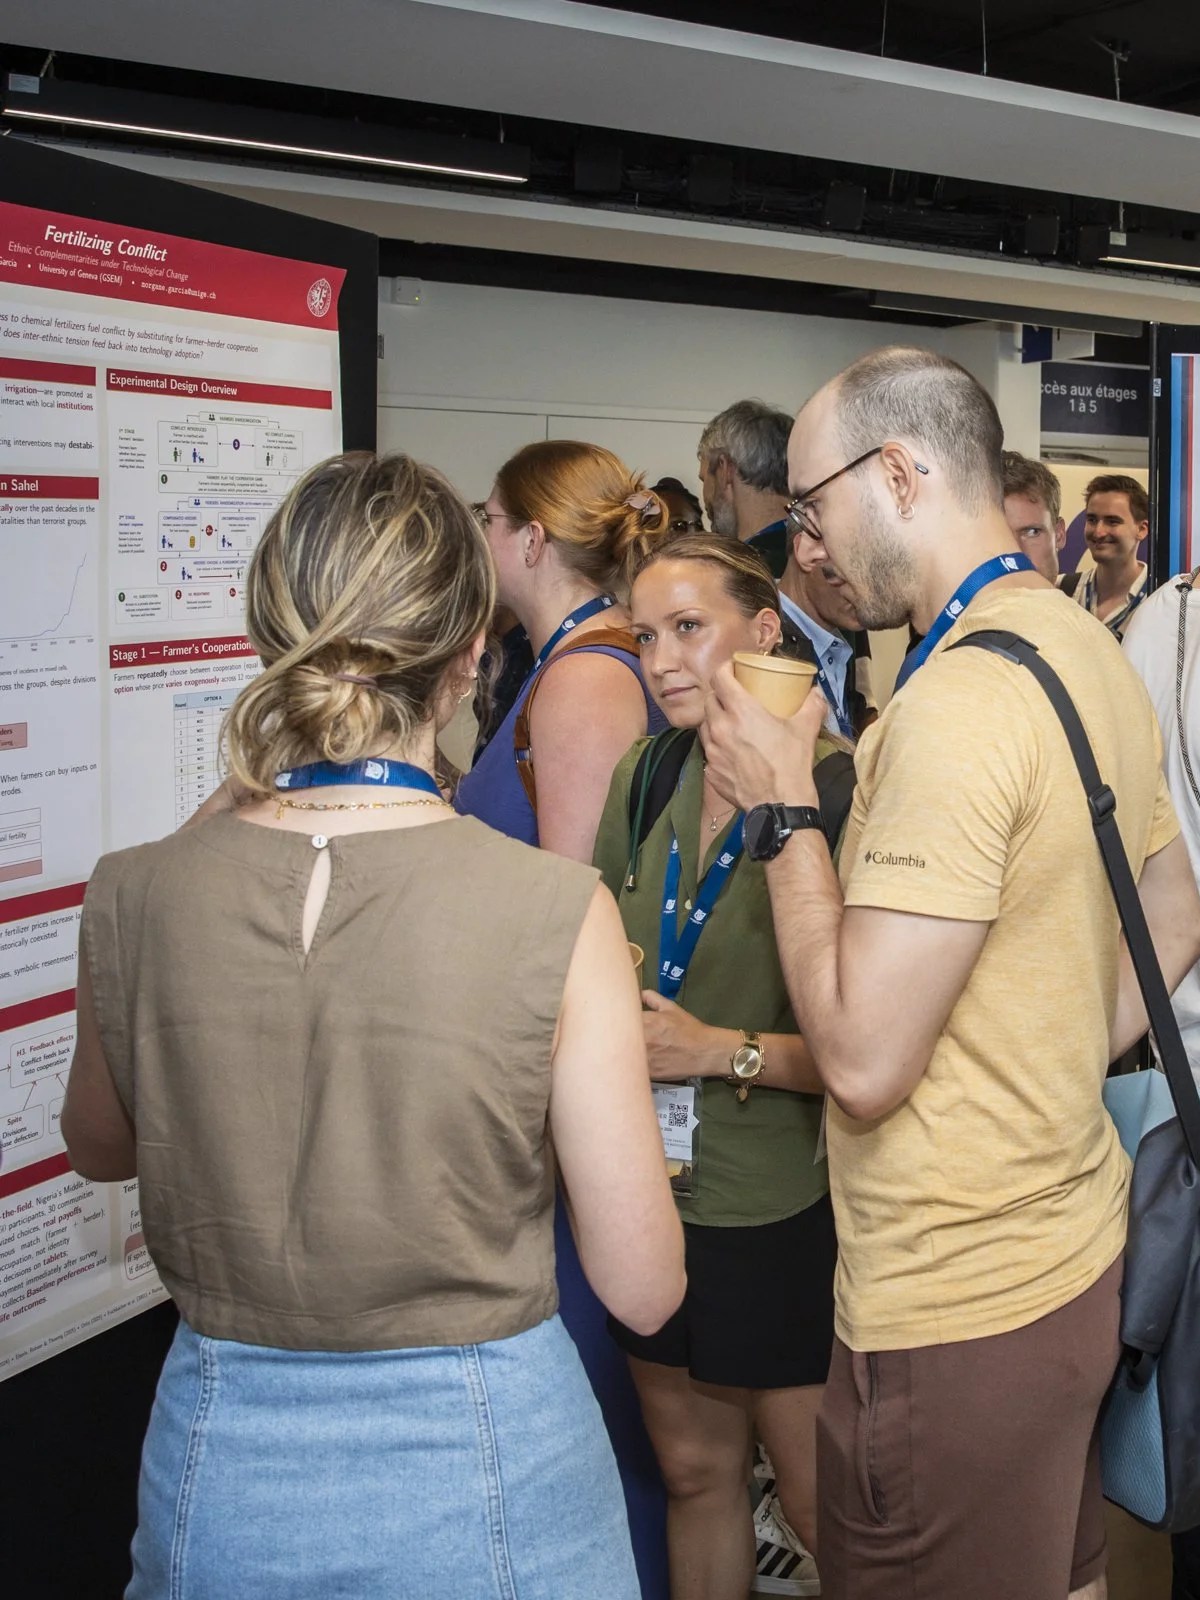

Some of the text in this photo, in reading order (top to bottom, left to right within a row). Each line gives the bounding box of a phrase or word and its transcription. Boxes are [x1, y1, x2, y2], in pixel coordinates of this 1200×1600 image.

[44, 225, 167, 261] Fertilizing Conflict
[8, 241, 188, 282] Ethnic Complementarities under Technological Change
[39, 263, 68, 277] University
[78, 270, 98, 280] Geneva
[100, 273, 123, 285] (GSEM)
[11, 314, 258, 353] to chemical fertilizers fuel conflict by substituting for cooperation
[3, 328, 203, 359] does inter-ethnic tension feed back into technology adoption?
[110, 373, 237, 395] Experimental Design Overview
[1040, 381, 1067, 395] ccès
[1070, 386, 1092, 396] aux
[1095, 383, 1137, 402] étages
[56, 390, 83, 398] promoted
[26, 398, 93, 410] with local institutions
[1069, 398, 1097, 413] 1 à 5
[14, 438, 52, 447] interventions
[11, 479, 38, 491] Sahel
[112, 650, 138, 662] Stage
[141, 648, 146, 658] 1
[202, 641, 251, 653] Cooperation
[114, 673, 135, 681] Farmers
[137, 669, 168, 680] repeatedly
[169, 667, 187, 676] choose
[213, 663, 241, 673] cooperation
[14, 676, 96, 690] the despite divisions
[114, 675, 220, 695] option whose varies exogenously
[0, 775, 18, 783] When
[21, 771, 42, 780] farmers
[58, 767, 68, 775] buy
[71, 765, 88, 773] inputs
[872, 852, 925, 868] Columbia
[5, 915, 73, 936] fertilizer prices increase
[14, 951, 77, 976] symbolic resentment?
[29, 1034, 73, 1052] Feedback effects
[20, 1047, 70, 1067] Conflict feeds back
[36, 1057, 67, 1072] cooperation
[2, 1126, 27, 1139] Divisions
[13, 1131, 38, 1144] defection
[64, 1181, 83, 1194] Middle
[58, 1190, 94, 1209] communities
[43, 1206, 81, 1228] real payoffs
[21, 1225, 67, 1249] match (farmer
[47, 1237, 70, 1251] identity
[4, 1267, 31, 1282] decisions
[26, 1250, 97, 1285] immediately after survey
[2, 1256, 107, 1308] collects Baseline preferences and
